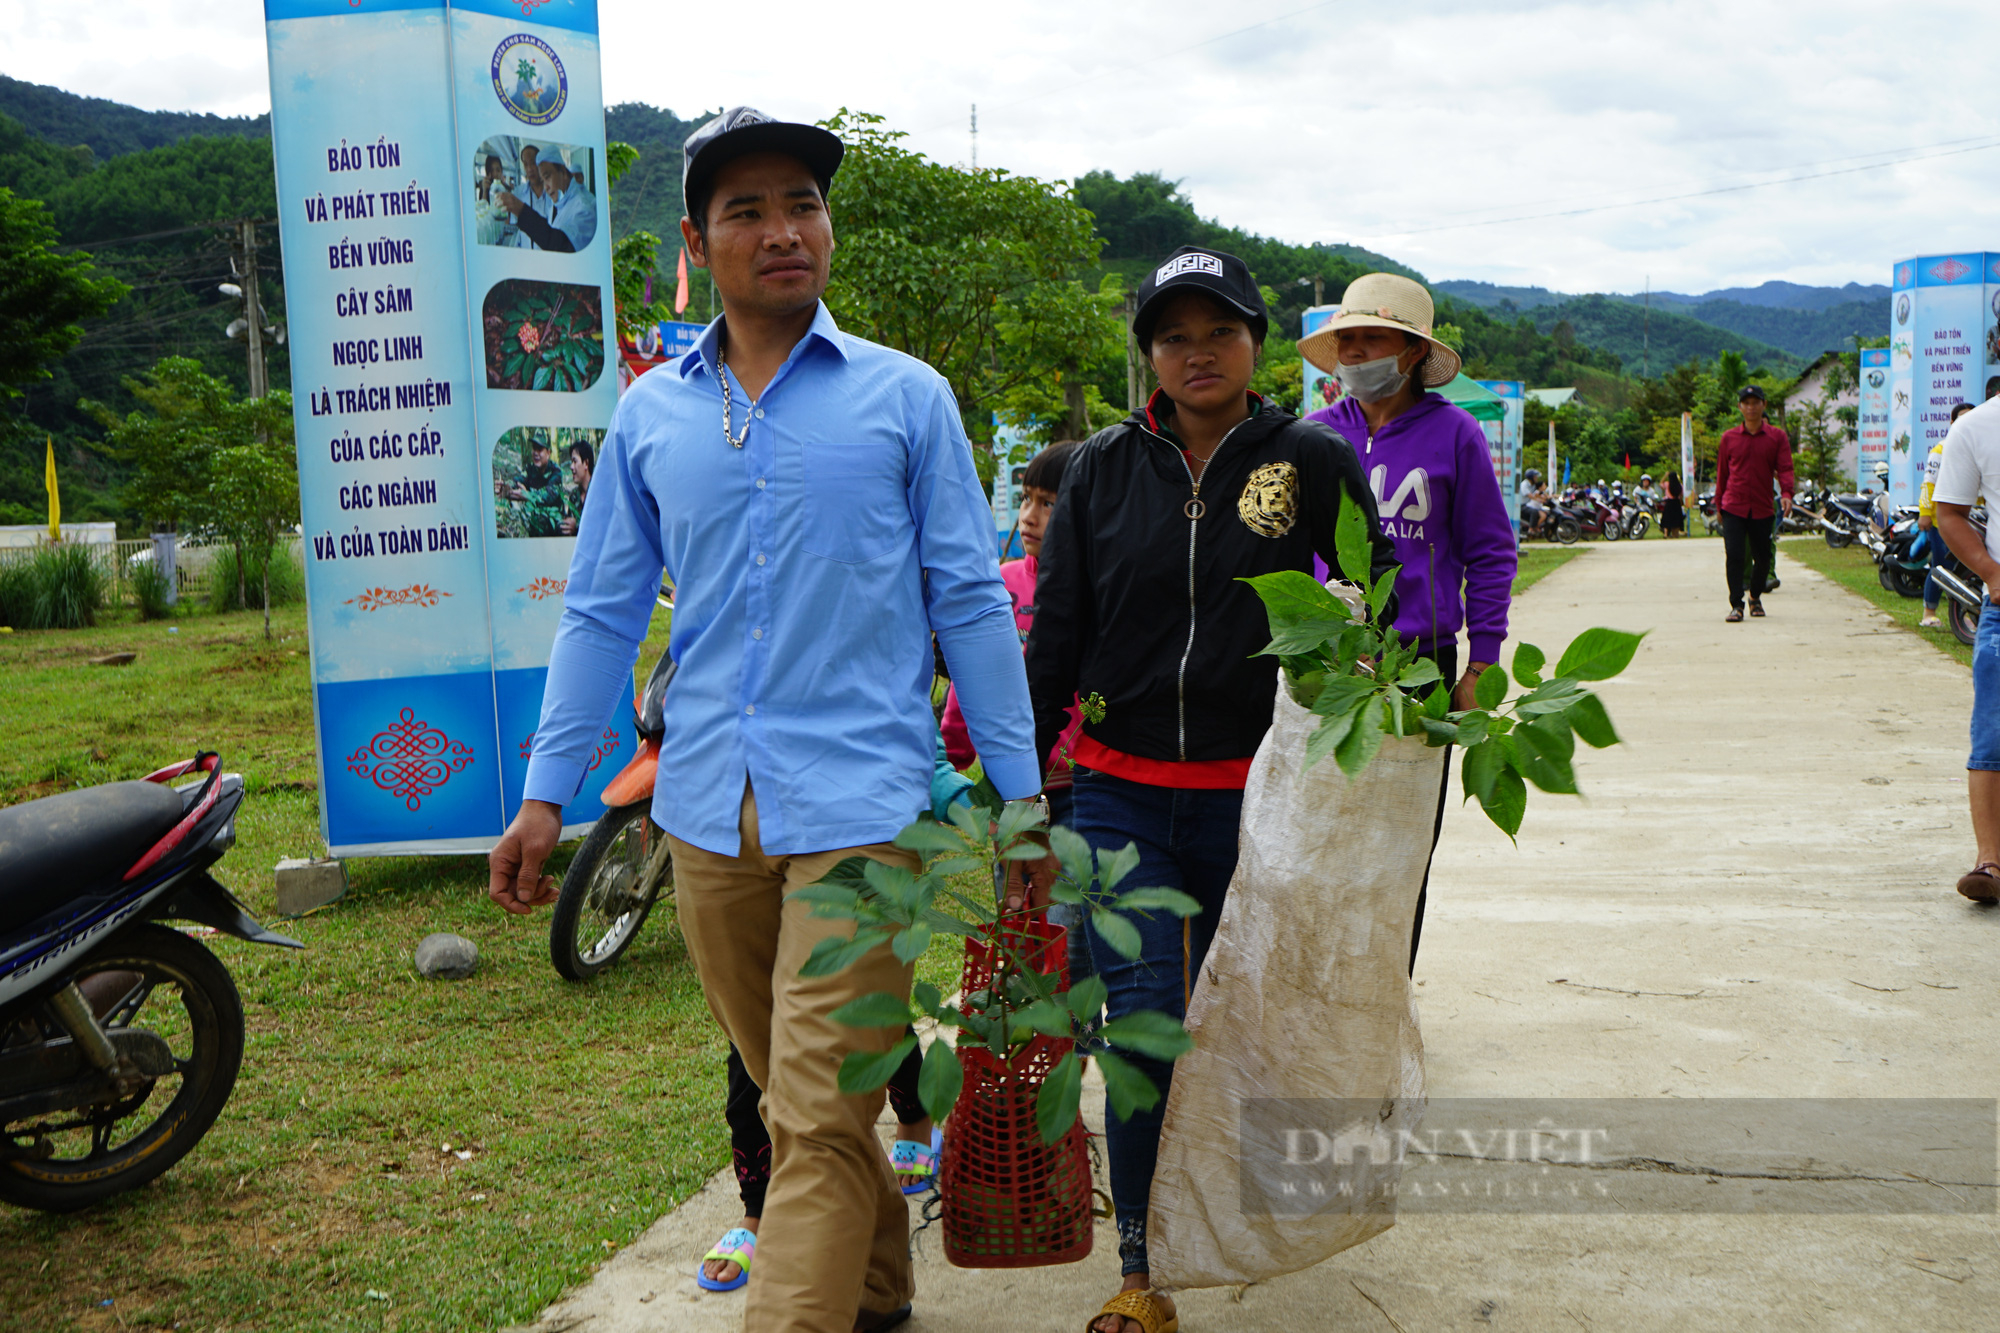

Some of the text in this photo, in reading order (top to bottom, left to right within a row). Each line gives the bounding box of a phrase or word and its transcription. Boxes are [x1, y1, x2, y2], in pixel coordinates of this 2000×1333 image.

[327, 135, 400, 171] BẢO TỒN
[304, 179, 429, 222] VÀ PHÁT TRIỂN
[328, 235, 413, 269] BỀN VỮNG
[336, 283, 412, 317] CÂY SÂM
[332, 334, 422, 369] NGỌC LINH
[310, 376, 451, 416] LÀ TRÁCH NHIỆM
[330, 421, 443, 462] CỦA CÁC CẤP,
[339, 475, 436, 510] CÁC NGÀNH
[313, 520, 468, 560] VÀ CỦA TOÀN DÂN!
